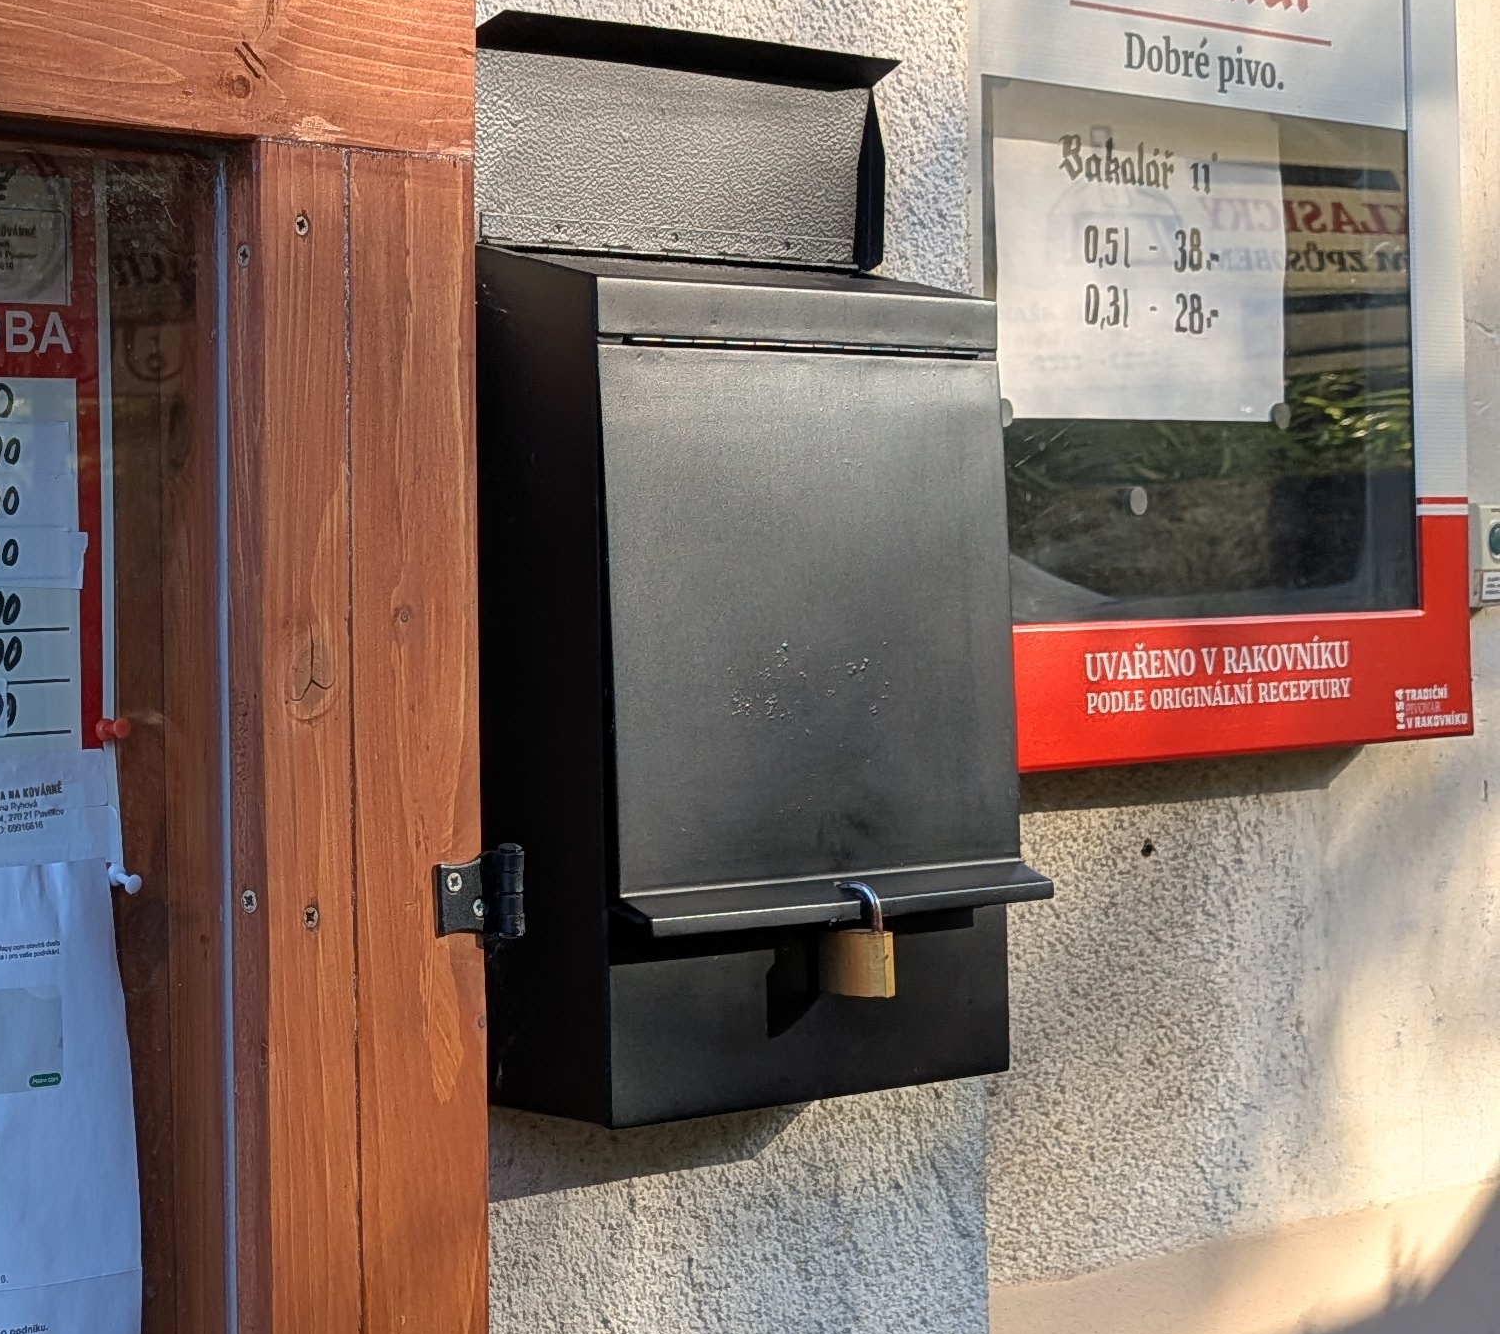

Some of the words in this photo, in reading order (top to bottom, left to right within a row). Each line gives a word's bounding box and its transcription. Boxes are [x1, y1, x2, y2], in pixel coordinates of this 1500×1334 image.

[1124, 31, 1210, 80] Dobré
[1217, 46, 1284, 93] pivo.
[1058, 132, 1176, 191] Bakalář
[1085, 642, 1196, 682] UVAŘENO
[1200, 649, 1218, 676] V
[1223, 635, 1350, 672] RAKOVNÍKU
[1086, 688, 1146, 715] PODLE
[1150, 679, 1253, 710] ORIGINÁLNÍ
[1258, 677, 1352, 705] RECEPTURY
[1405, 684, 1448, 701] TRADIČNÍ
[1415, 712, 1468, 728] RAKOVNÍKU
[8, 788, 20, 799] NA
[9, 813, 22, 822] 270
[24, 811, 32, 820] 21
